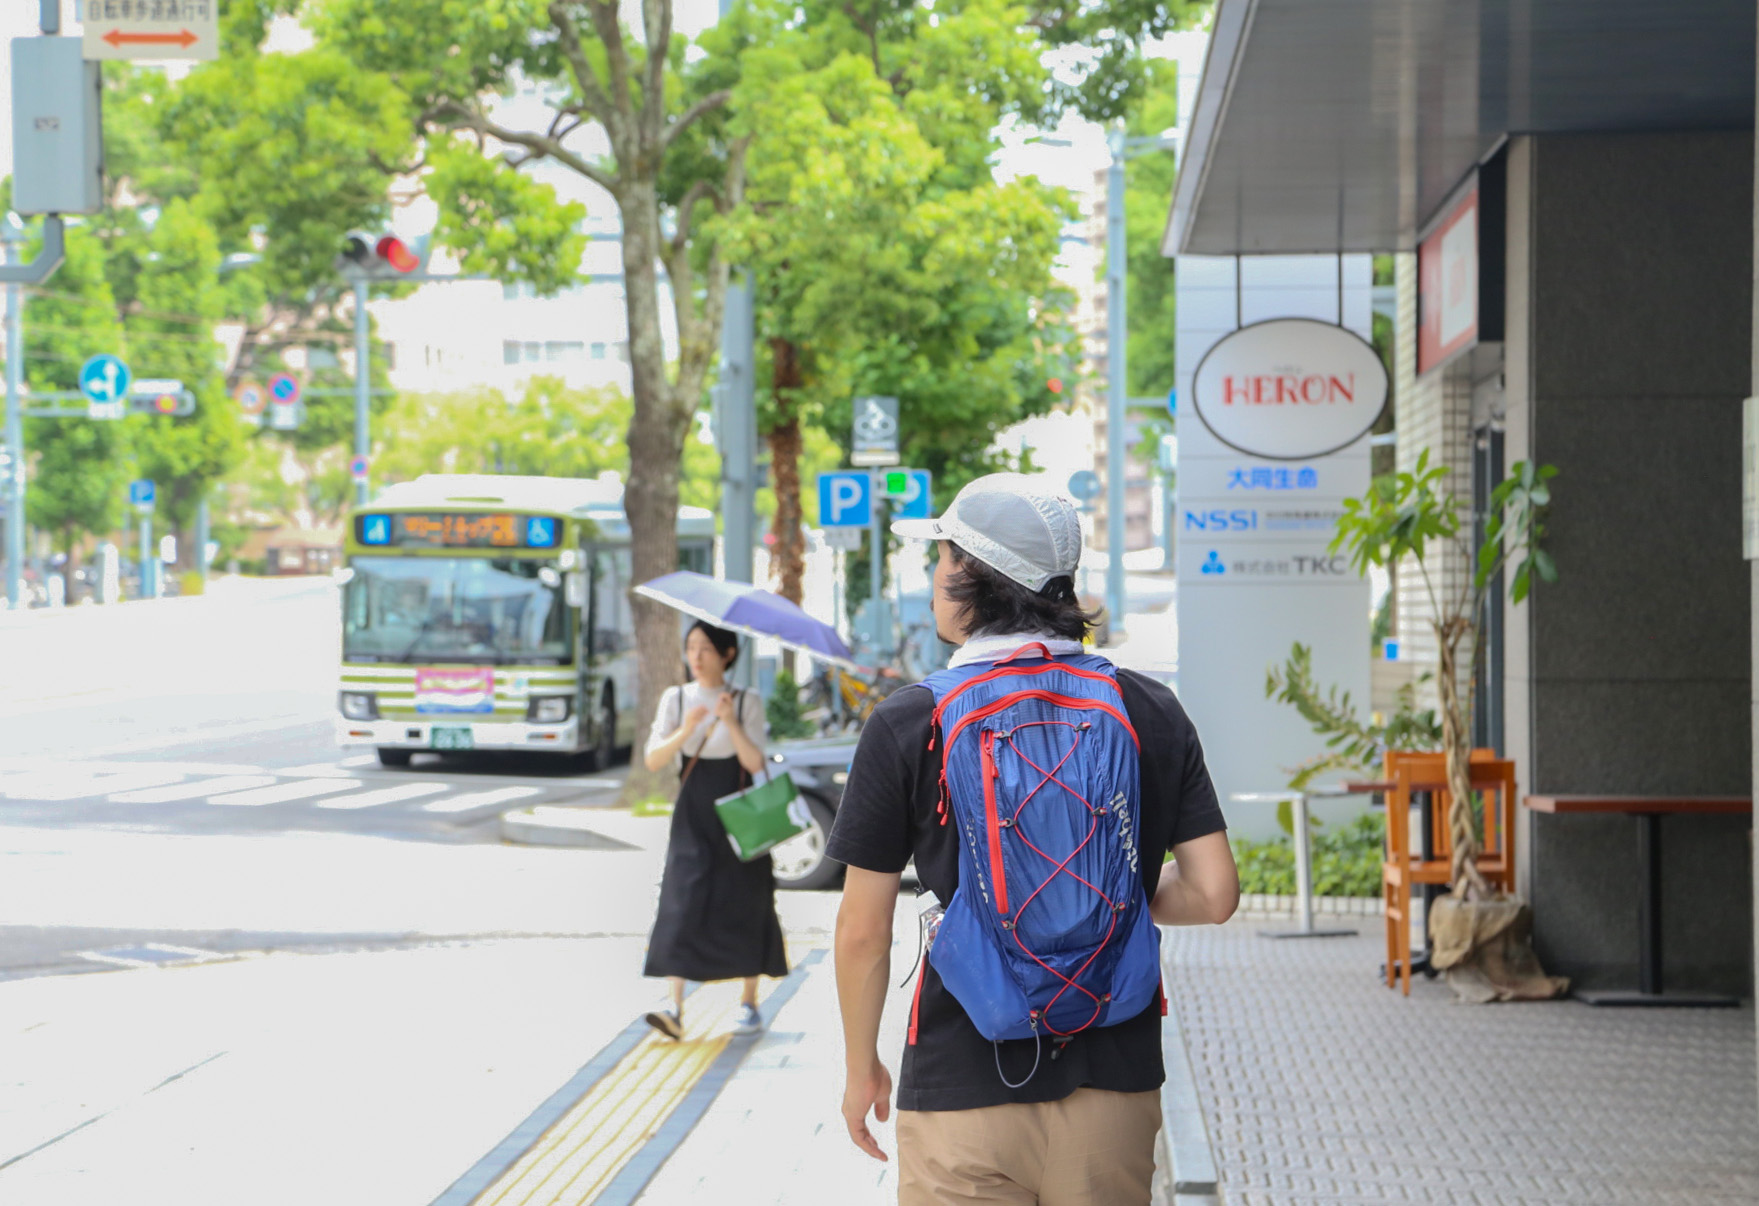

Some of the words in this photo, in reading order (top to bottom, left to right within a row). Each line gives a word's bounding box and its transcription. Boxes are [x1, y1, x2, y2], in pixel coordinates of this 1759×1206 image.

[1223, 372, 1355, 406] HERON
[1227, 466, 1318, 490] 大同生命
[830, 478, 863, 523] P
[1184, 510, 1258, 531] NSSI
